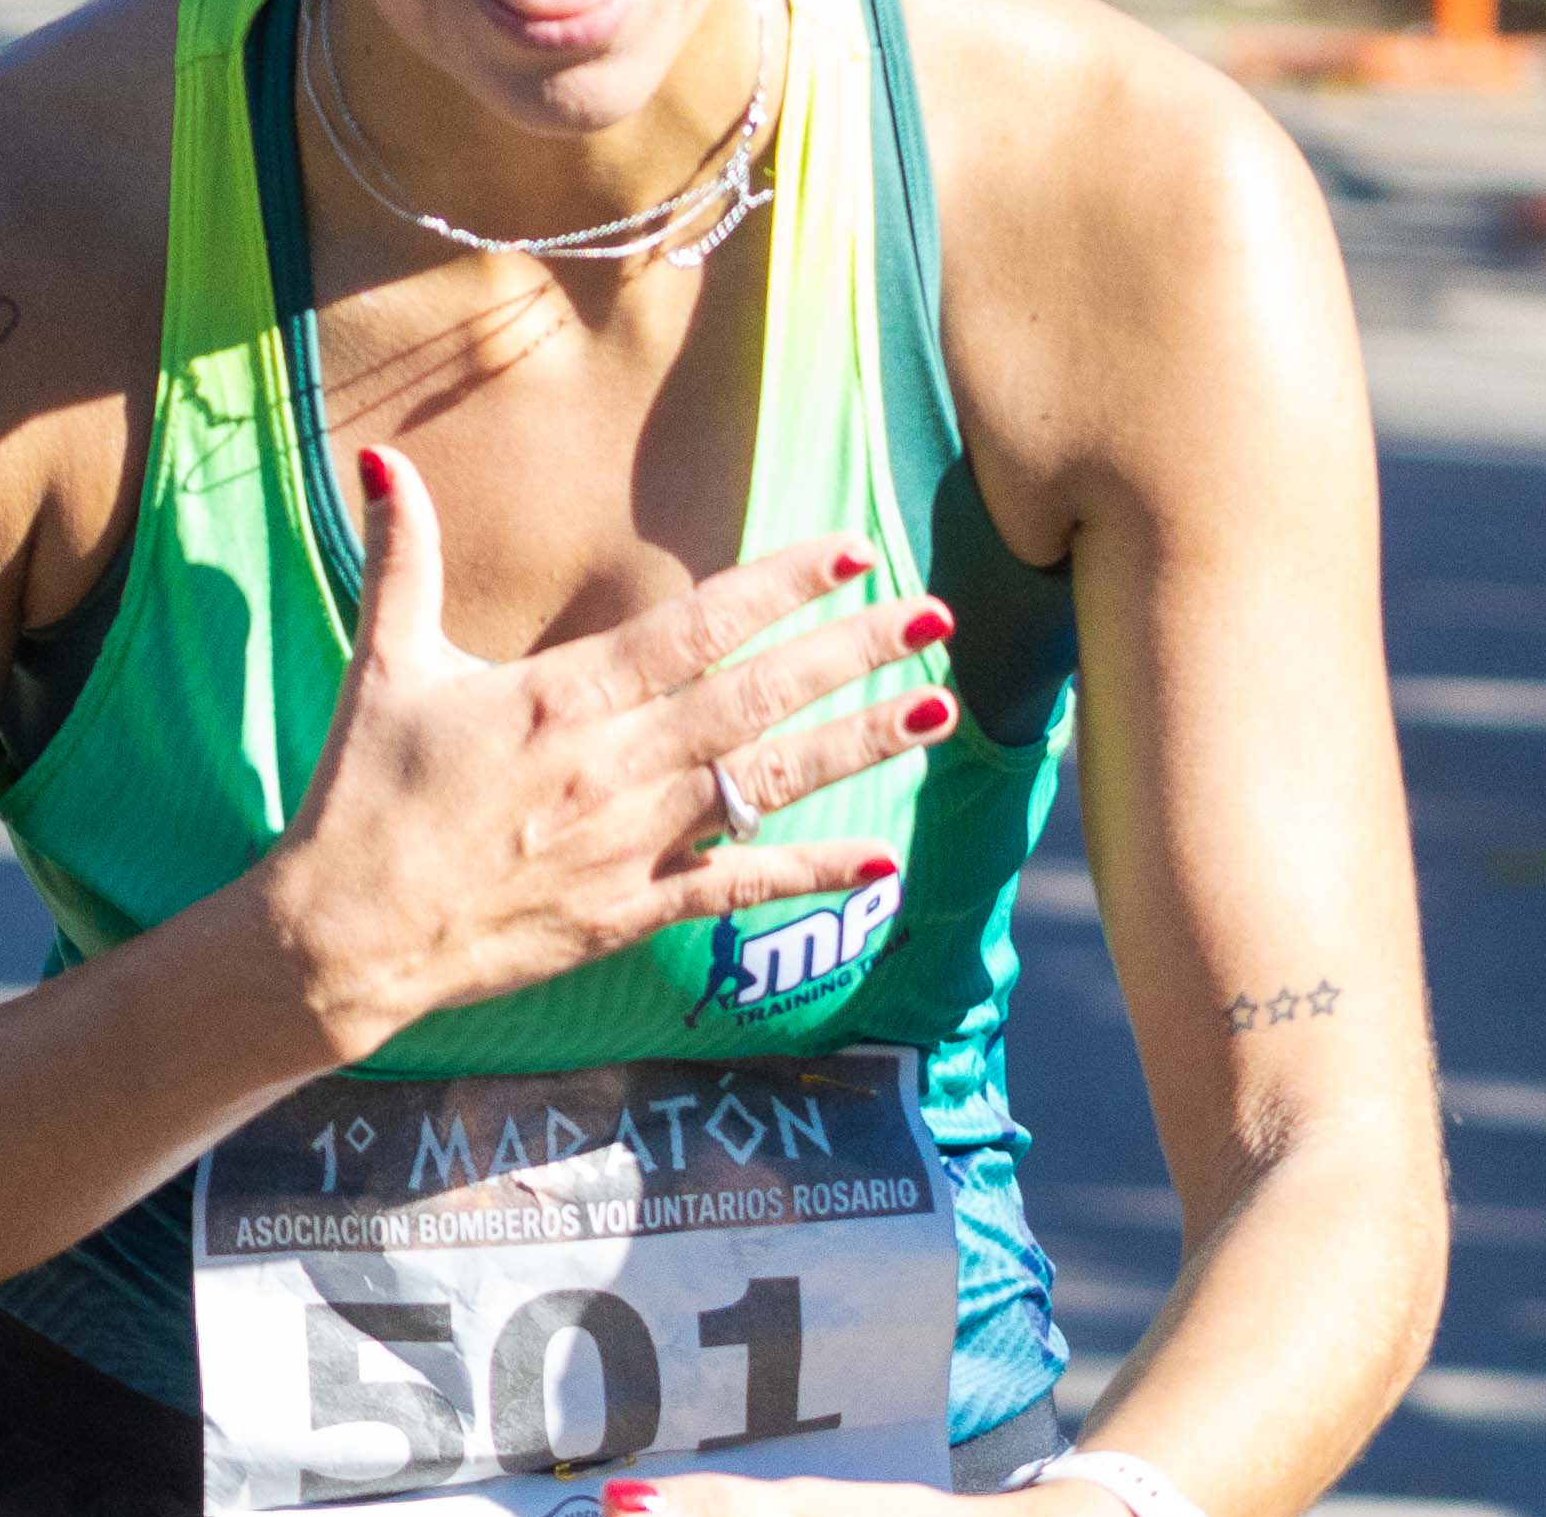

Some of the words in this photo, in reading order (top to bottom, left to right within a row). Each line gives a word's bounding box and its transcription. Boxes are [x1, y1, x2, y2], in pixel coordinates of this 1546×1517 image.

[733, 967, 853, 1027] TRAINING
[407, 1072, 833, 1192] MARATÓN
[236, 1206, 410, 1249] ASOCIACIÓN
[419, 1205, 581, 1245] BOMBEROS
[586, 1184, 784, 1235] VOLUNTARIOS
[793, 1176, 919, 1216] ROSARIO
[299, 1275, 843, 1504] 501
